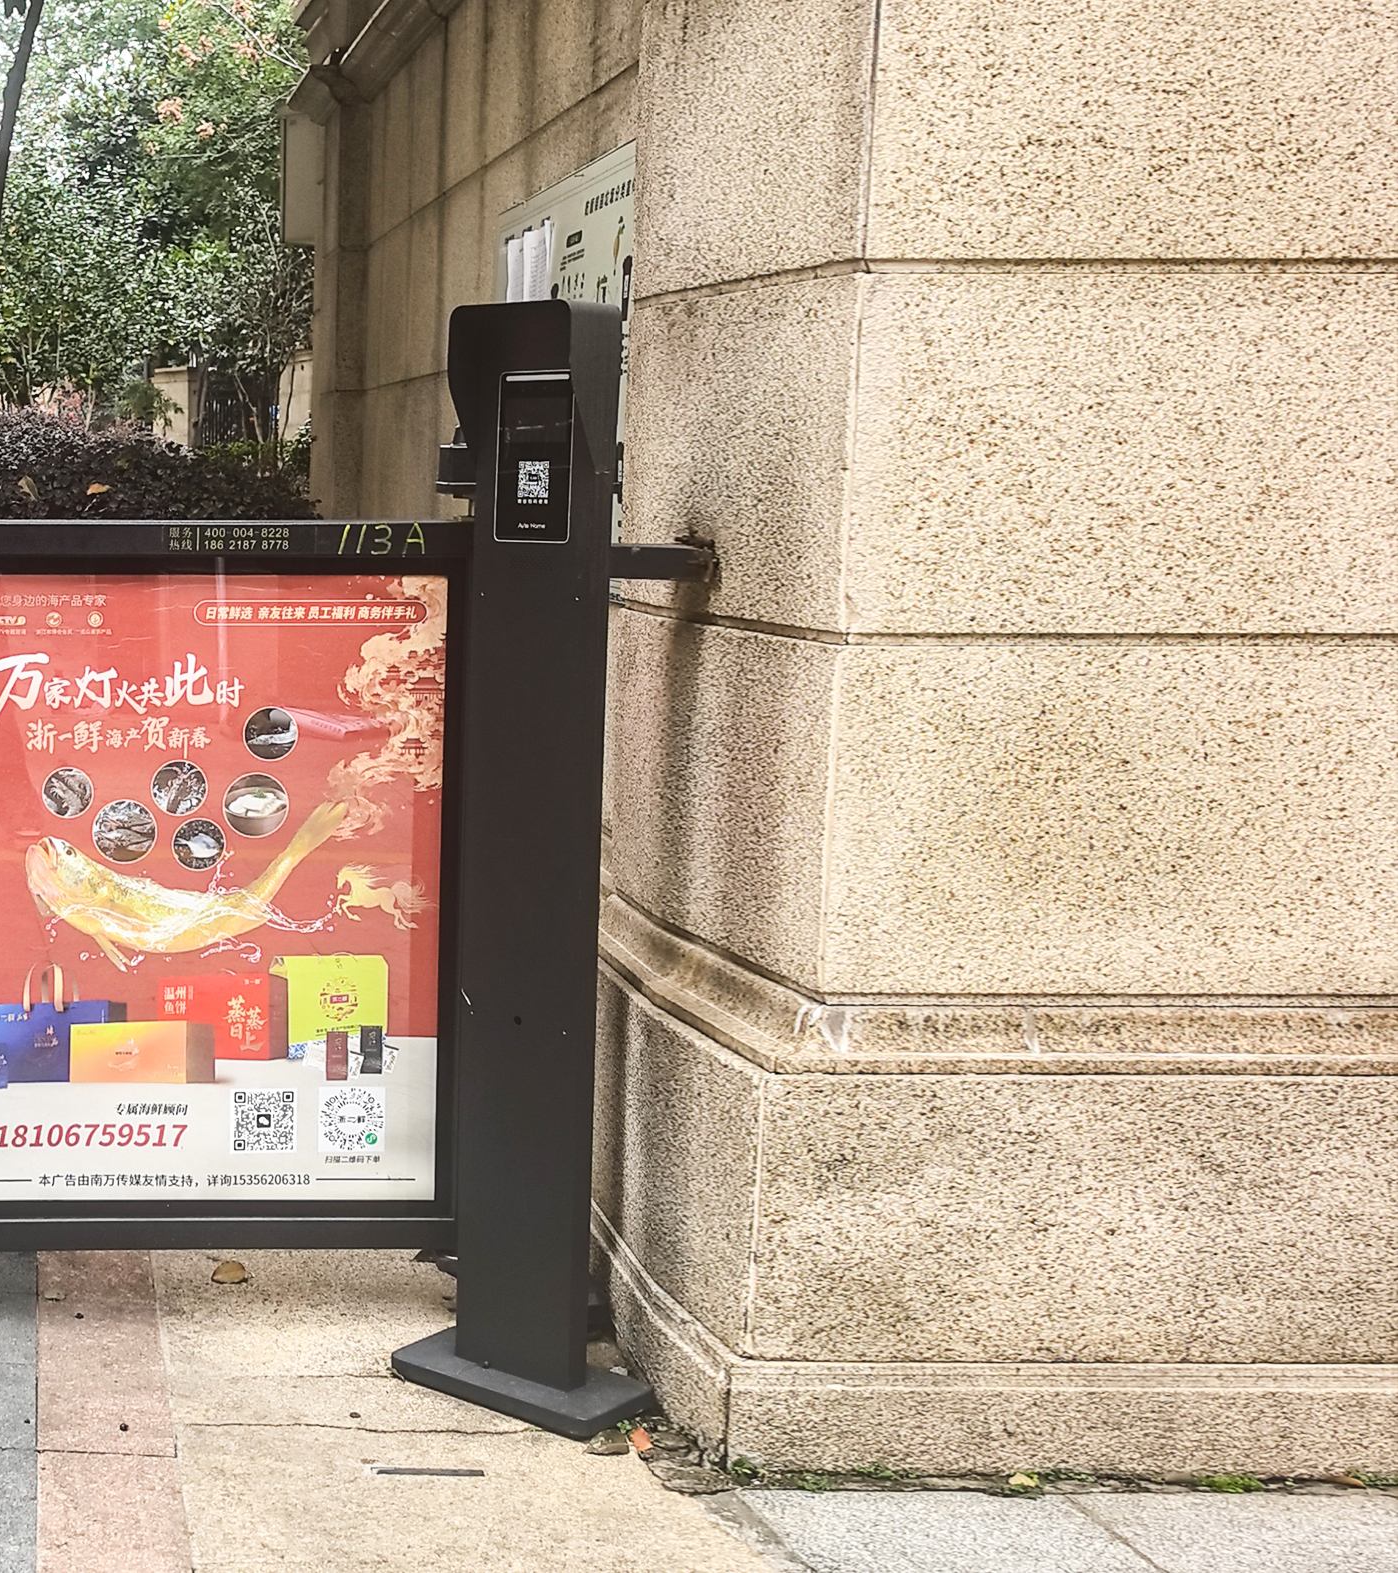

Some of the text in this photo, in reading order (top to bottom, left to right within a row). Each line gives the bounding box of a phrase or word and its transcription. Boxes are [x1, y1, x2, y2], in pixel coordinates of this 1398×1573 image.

[169, 527, 290, 538] 服务 400-004-8228
[169, 539, 290, 551] 热线 186 2187 8778
[0, 594, 108, 607] 您身边的海产品专家
[206, 606, 417, 619] 日常鲜选 亲友往来 员工福利 商务伴手礼
[26, 716, 212, 759] 浙一鲜海产贺新春
[164, 986, 187, 1000] 温州
[164, 1001, 187, 1015] 鱼饼
[115, 1103, 188, 1116] 专属海鲜顾问
[325, 1155, 380, 1164] 扫描二维码下单
